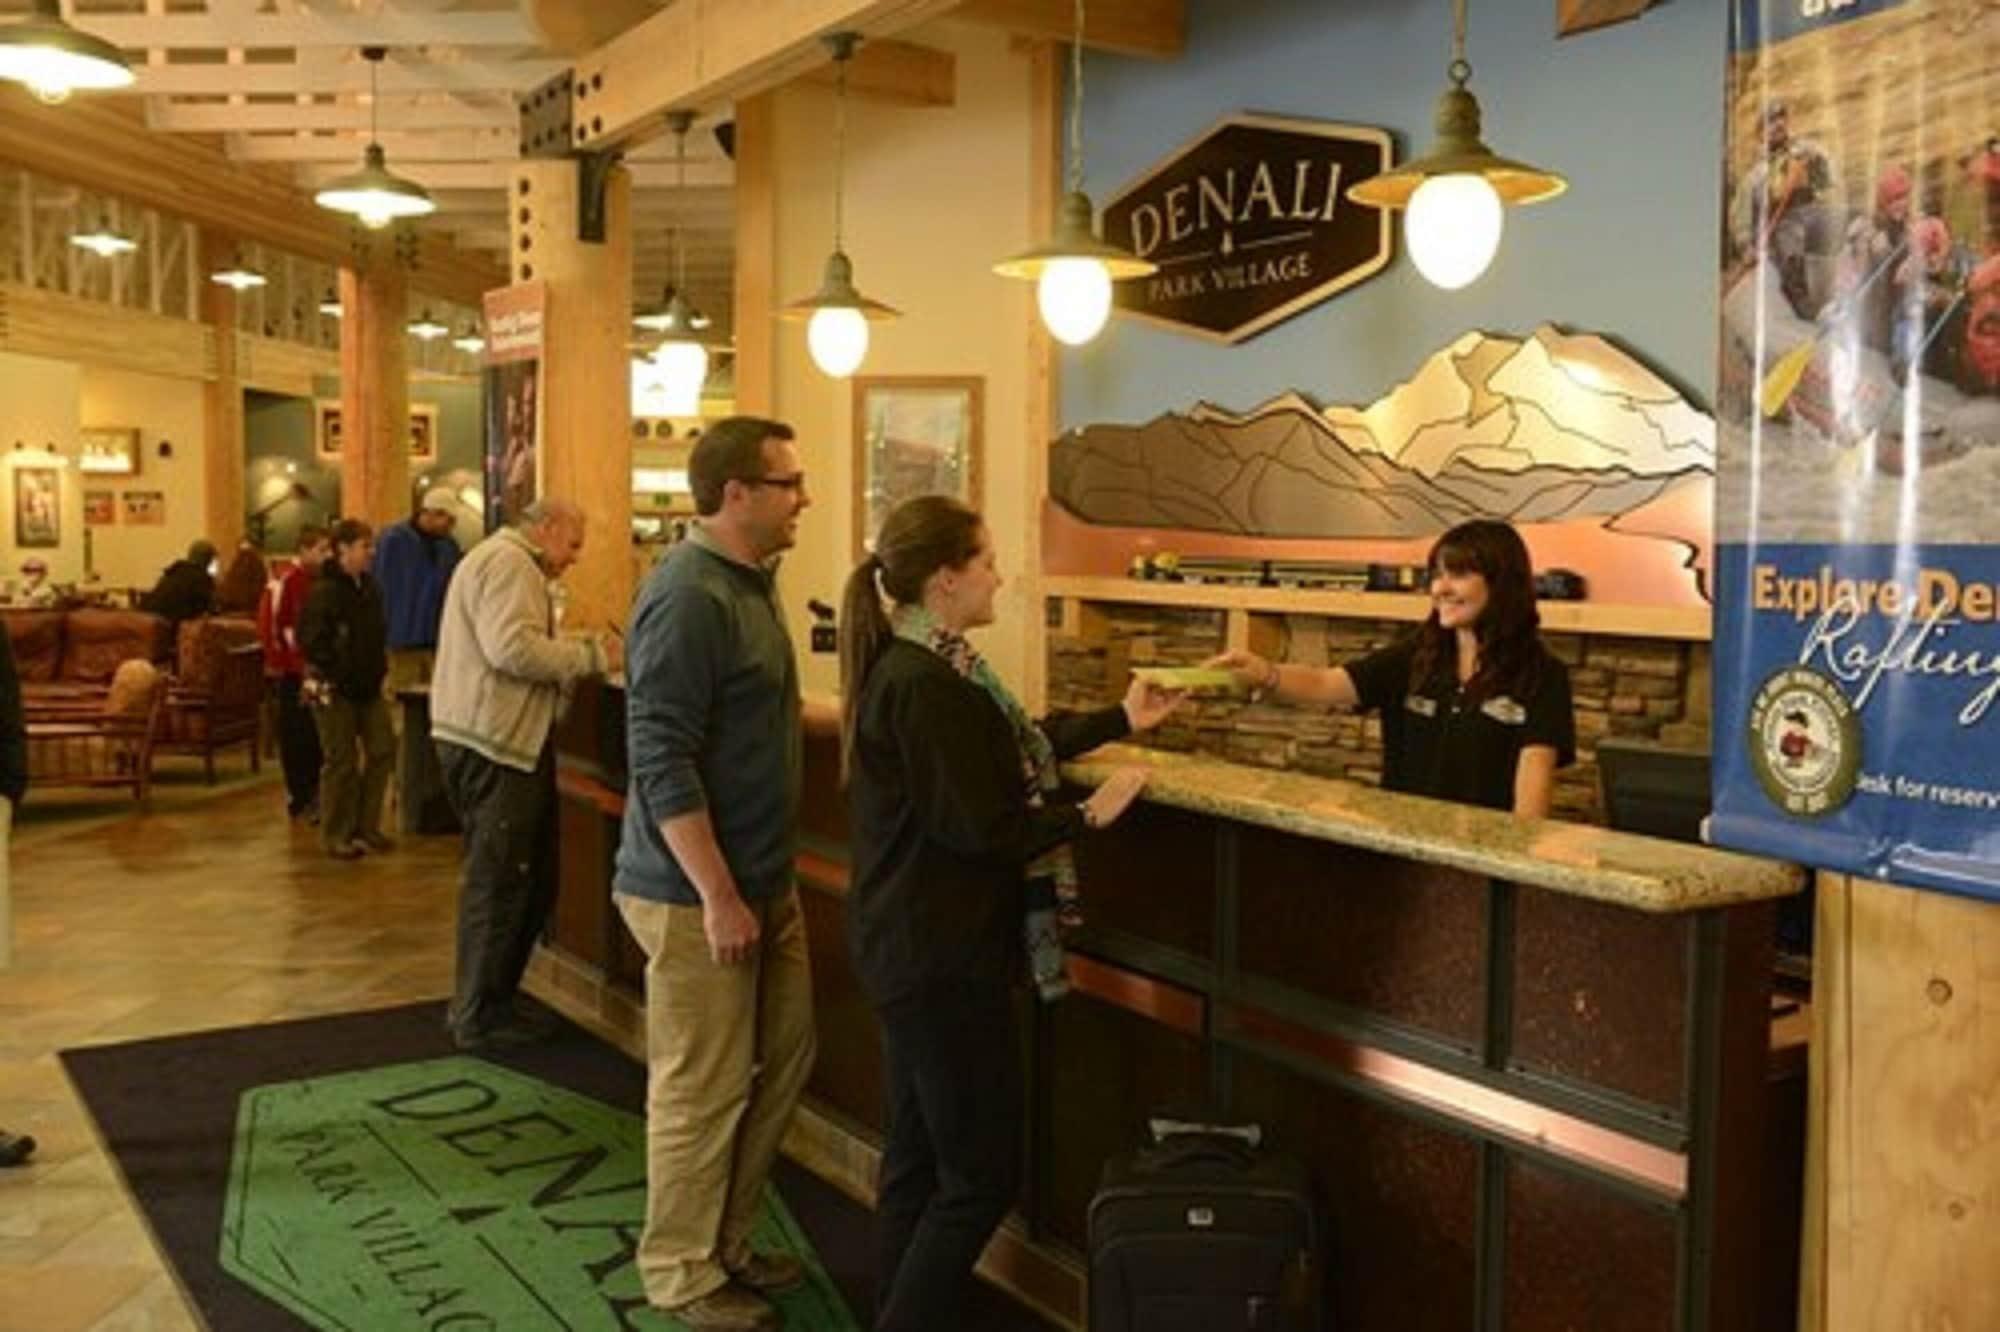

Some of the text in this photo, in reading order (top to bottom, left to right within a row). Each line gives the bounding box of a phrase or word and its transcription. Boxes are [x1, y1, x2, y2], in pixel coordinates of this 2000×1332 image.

[1130, 160, 1342, 257] DENALI
[1149, 251, 1313, 301] PARK VILLAGE
[1753, 563, 2000, 626] Explore De
[272, 1121, 375, 1205] PARK
